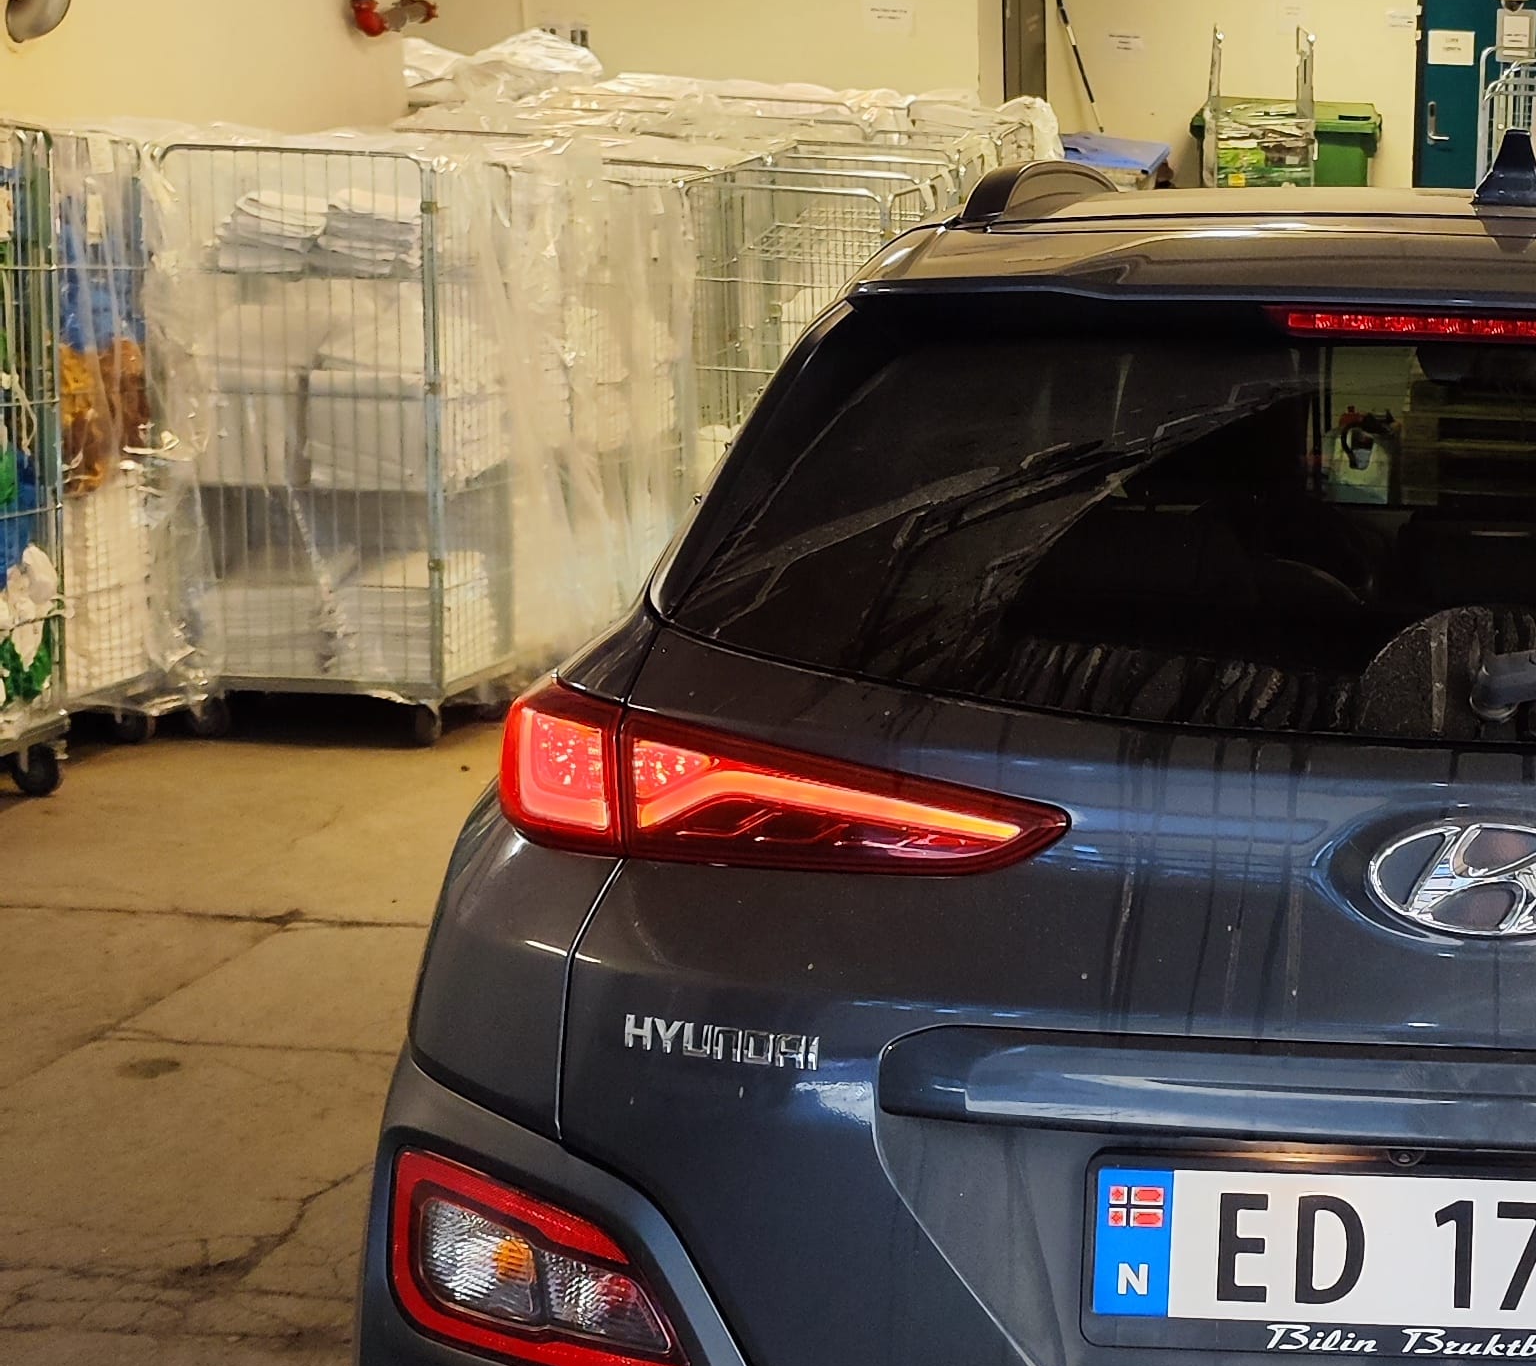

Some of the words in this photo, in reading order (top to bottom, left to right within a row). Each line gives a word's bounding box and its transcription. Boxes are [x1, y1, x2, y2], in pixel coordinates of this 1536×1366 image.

[625, 1014, 820, 1071] HYUNDAI
[1216, 1192, 1366, 1304] ED
[1116, 1262, 1149, 1295] N
[1266, 1323, 1378, 1353] Bilin
